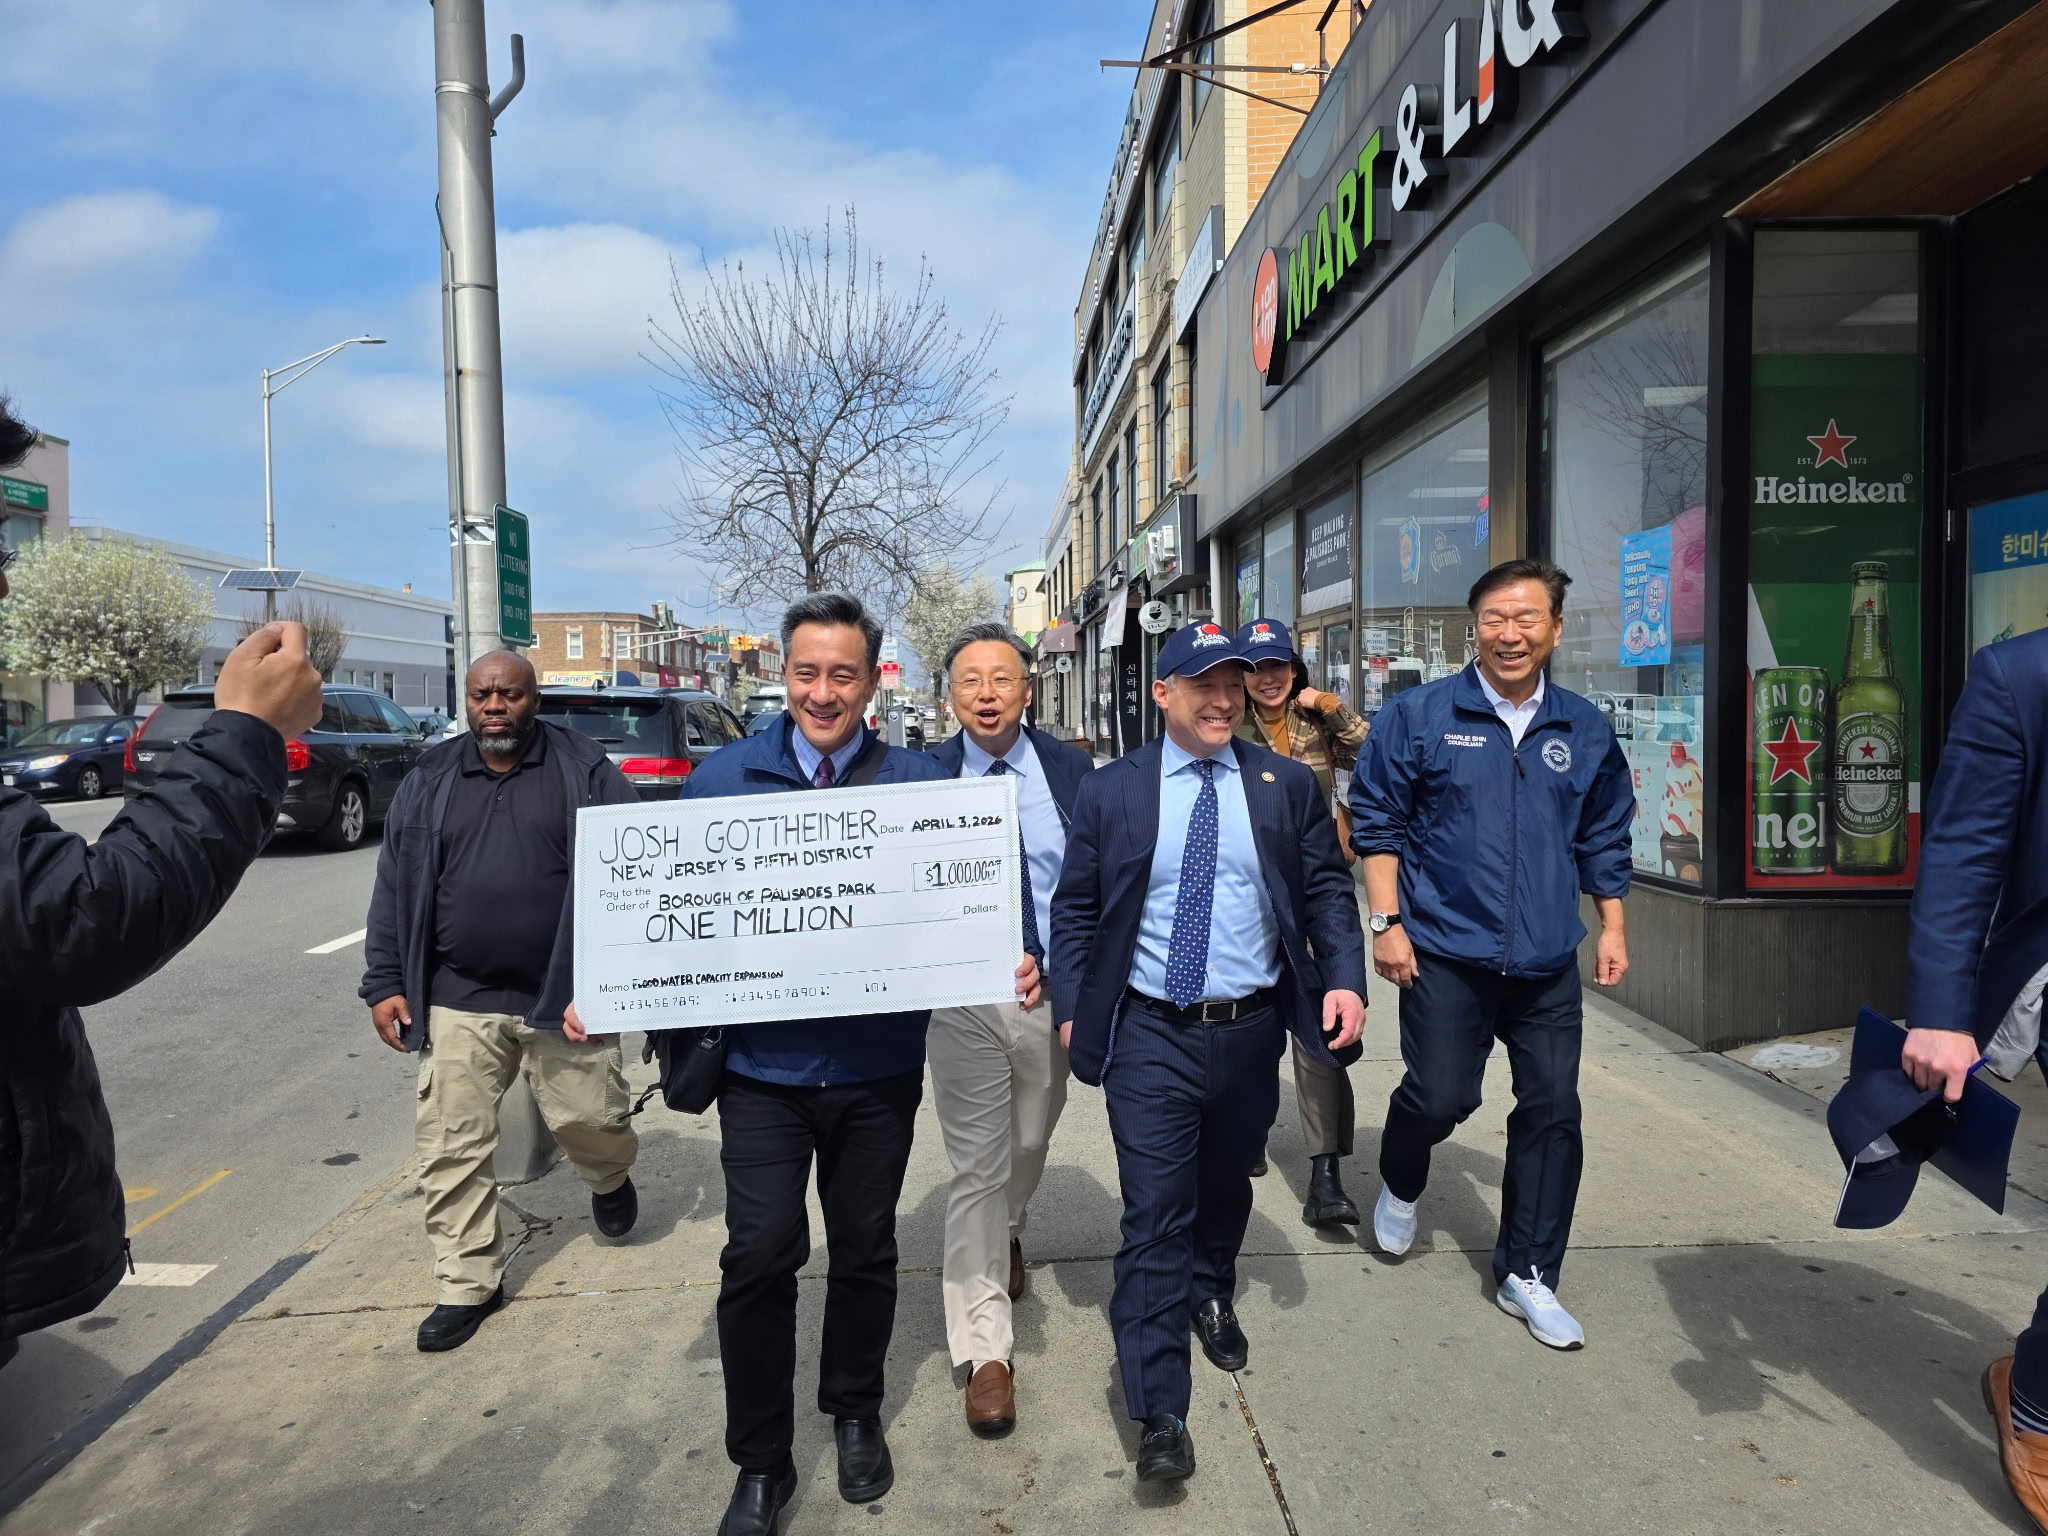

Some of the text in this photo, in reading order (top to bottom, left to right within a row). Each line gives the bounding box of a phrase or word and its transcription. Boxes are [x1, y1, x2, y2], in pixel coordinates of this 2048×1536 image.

[1286, 128, 1381, 342] MART
[1391, 83, 1428, 212] &
[1797, 457, 1867, 465] EST. 1873
[1754, 475, 1908, 504] Heineken
[1311, 513, 1344, 544] KEEP WALKING
[509, 531, 518, 548] NO
[1310, 532, 1347, 562] PALISADES PARK
[1430, 549, 1459, 573] Corona
[1624, 548, 1651, 563] Deliciously
[500, 552, 528, 576] LITTERING
[1624, 562, 1647, 575] Tempting
[1624, 573, 1648, 587] Spicy and
[504, 580, 526, 599] $100 FINE
[1624, 587, 1639, 598] Sweet
[504, 604, 515, 618] ORD.
[1627, 601, 1640, 614] BHD
[1194, 625, 1203, 638] I
[1248, 632, 1276, 644] PALISADES
[1251, 625, 1257, 635] I
[1863, 611, 1873, 660] Heineken
[1192, 633, 1231, 649] PALISADES
[1203, 640, 1226, 648] PARK
[547, 674, 592, 683] Cleaners
[1125, 663, 1138, 717] 신라제과
[1444, 733, 1487, 743] CHARLIE SHIN
[1447, 739, 1483, 748] COUNCILMAN
[1838, 725, 1899, 756] HEINEKEN ORIGINAL
[1834, 765, 1903, 781] Heineken
[1837, 796, 1898, 825] PREMIUM MALT LAGER
[879, 824, 905, 835] Date
[912, 817, 955, 833] APRIL
[599, 809, 879, 864] JOSH GOTTHEIMER
[611, 845, 874, 883] NEW JERSEY'S FIFTH DISTRICT
[599, 887, 651, 900] Pay to the
[659, 882, 876, 911] BOROUGH OF PALISADES PARK
[606, 901, 650, 912] Order of
[962, 903, 998, 915] Dollars
[645, 904, 853, 943] ONE MILLION
[695, 972, 732, 986] CAPACITY
[733, 969, 784, 982] EXPANSION
[599, 983, 630, 994] Memo
